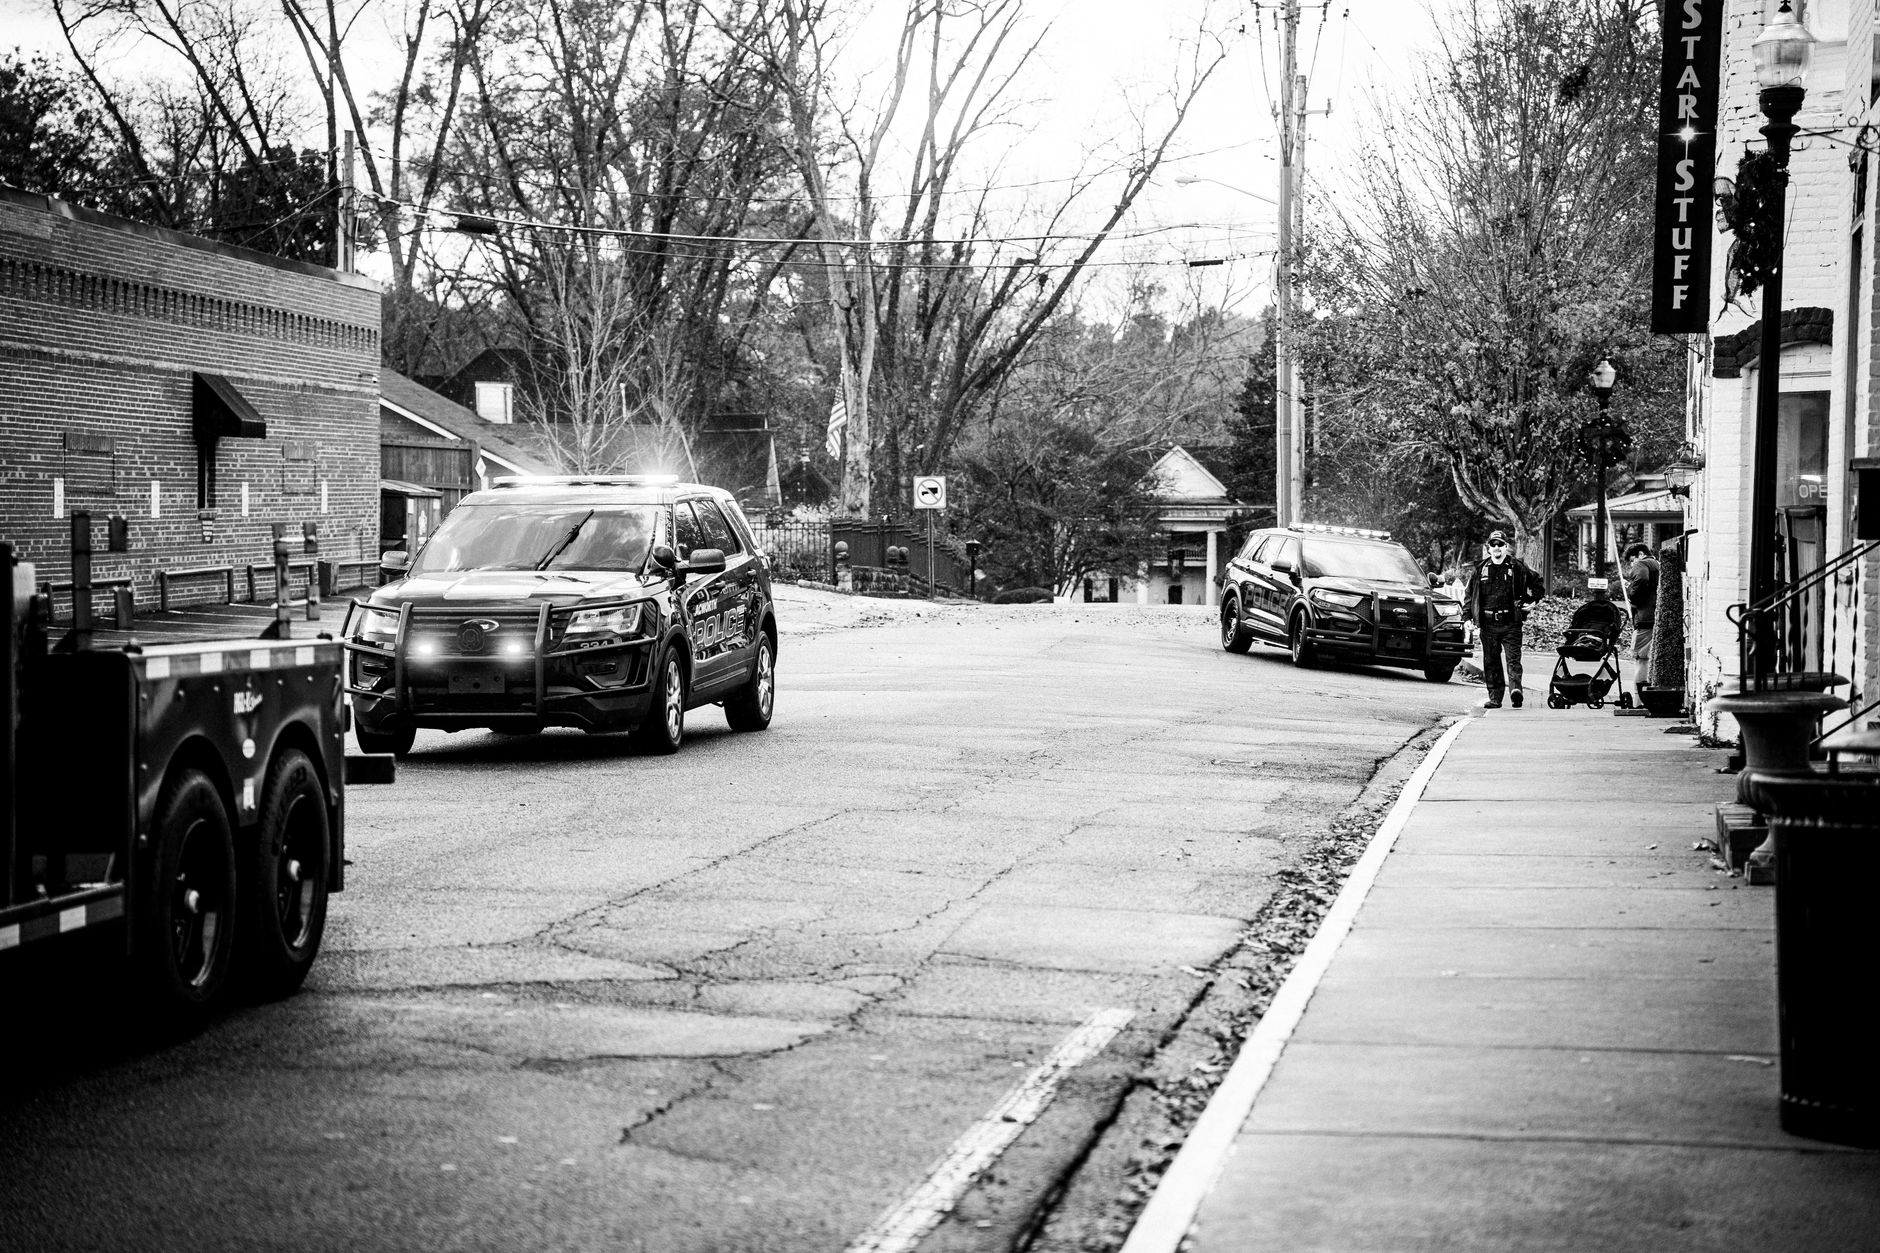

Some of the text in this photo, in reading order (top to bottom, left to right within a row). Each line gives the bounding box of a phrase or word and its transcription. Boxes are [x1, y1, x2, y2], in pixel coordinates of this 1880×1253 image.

[1675, 0, 1702, 119] STAR
[1672, 159, 1695, 310] STUFF
[1799, 484, 1828, 498] OPE
[694, 604, 746, 647] POLICE
